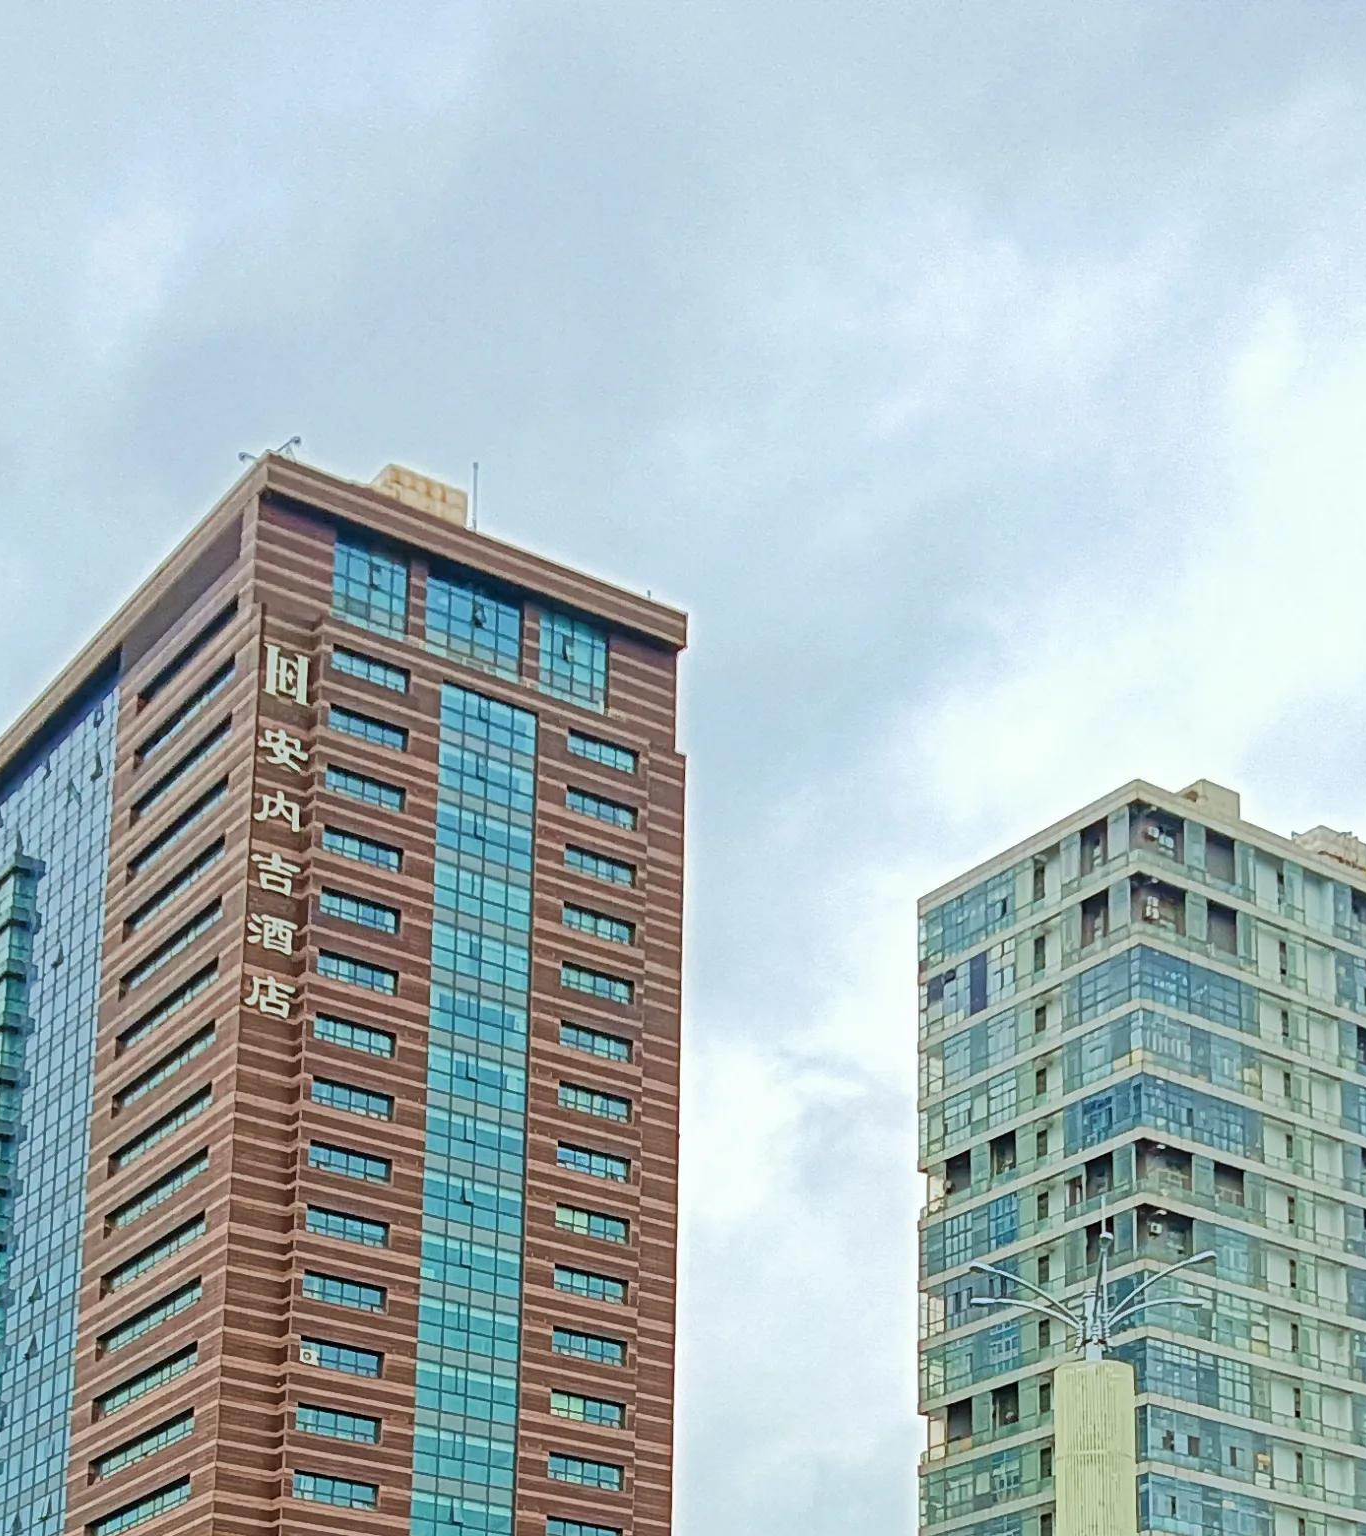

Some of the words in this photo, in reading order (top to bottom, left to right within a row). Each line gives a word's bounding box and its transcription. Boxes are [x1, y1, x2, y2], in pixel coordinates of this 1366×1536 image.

[244, 728, 309, 1018] 安内吉酒店
